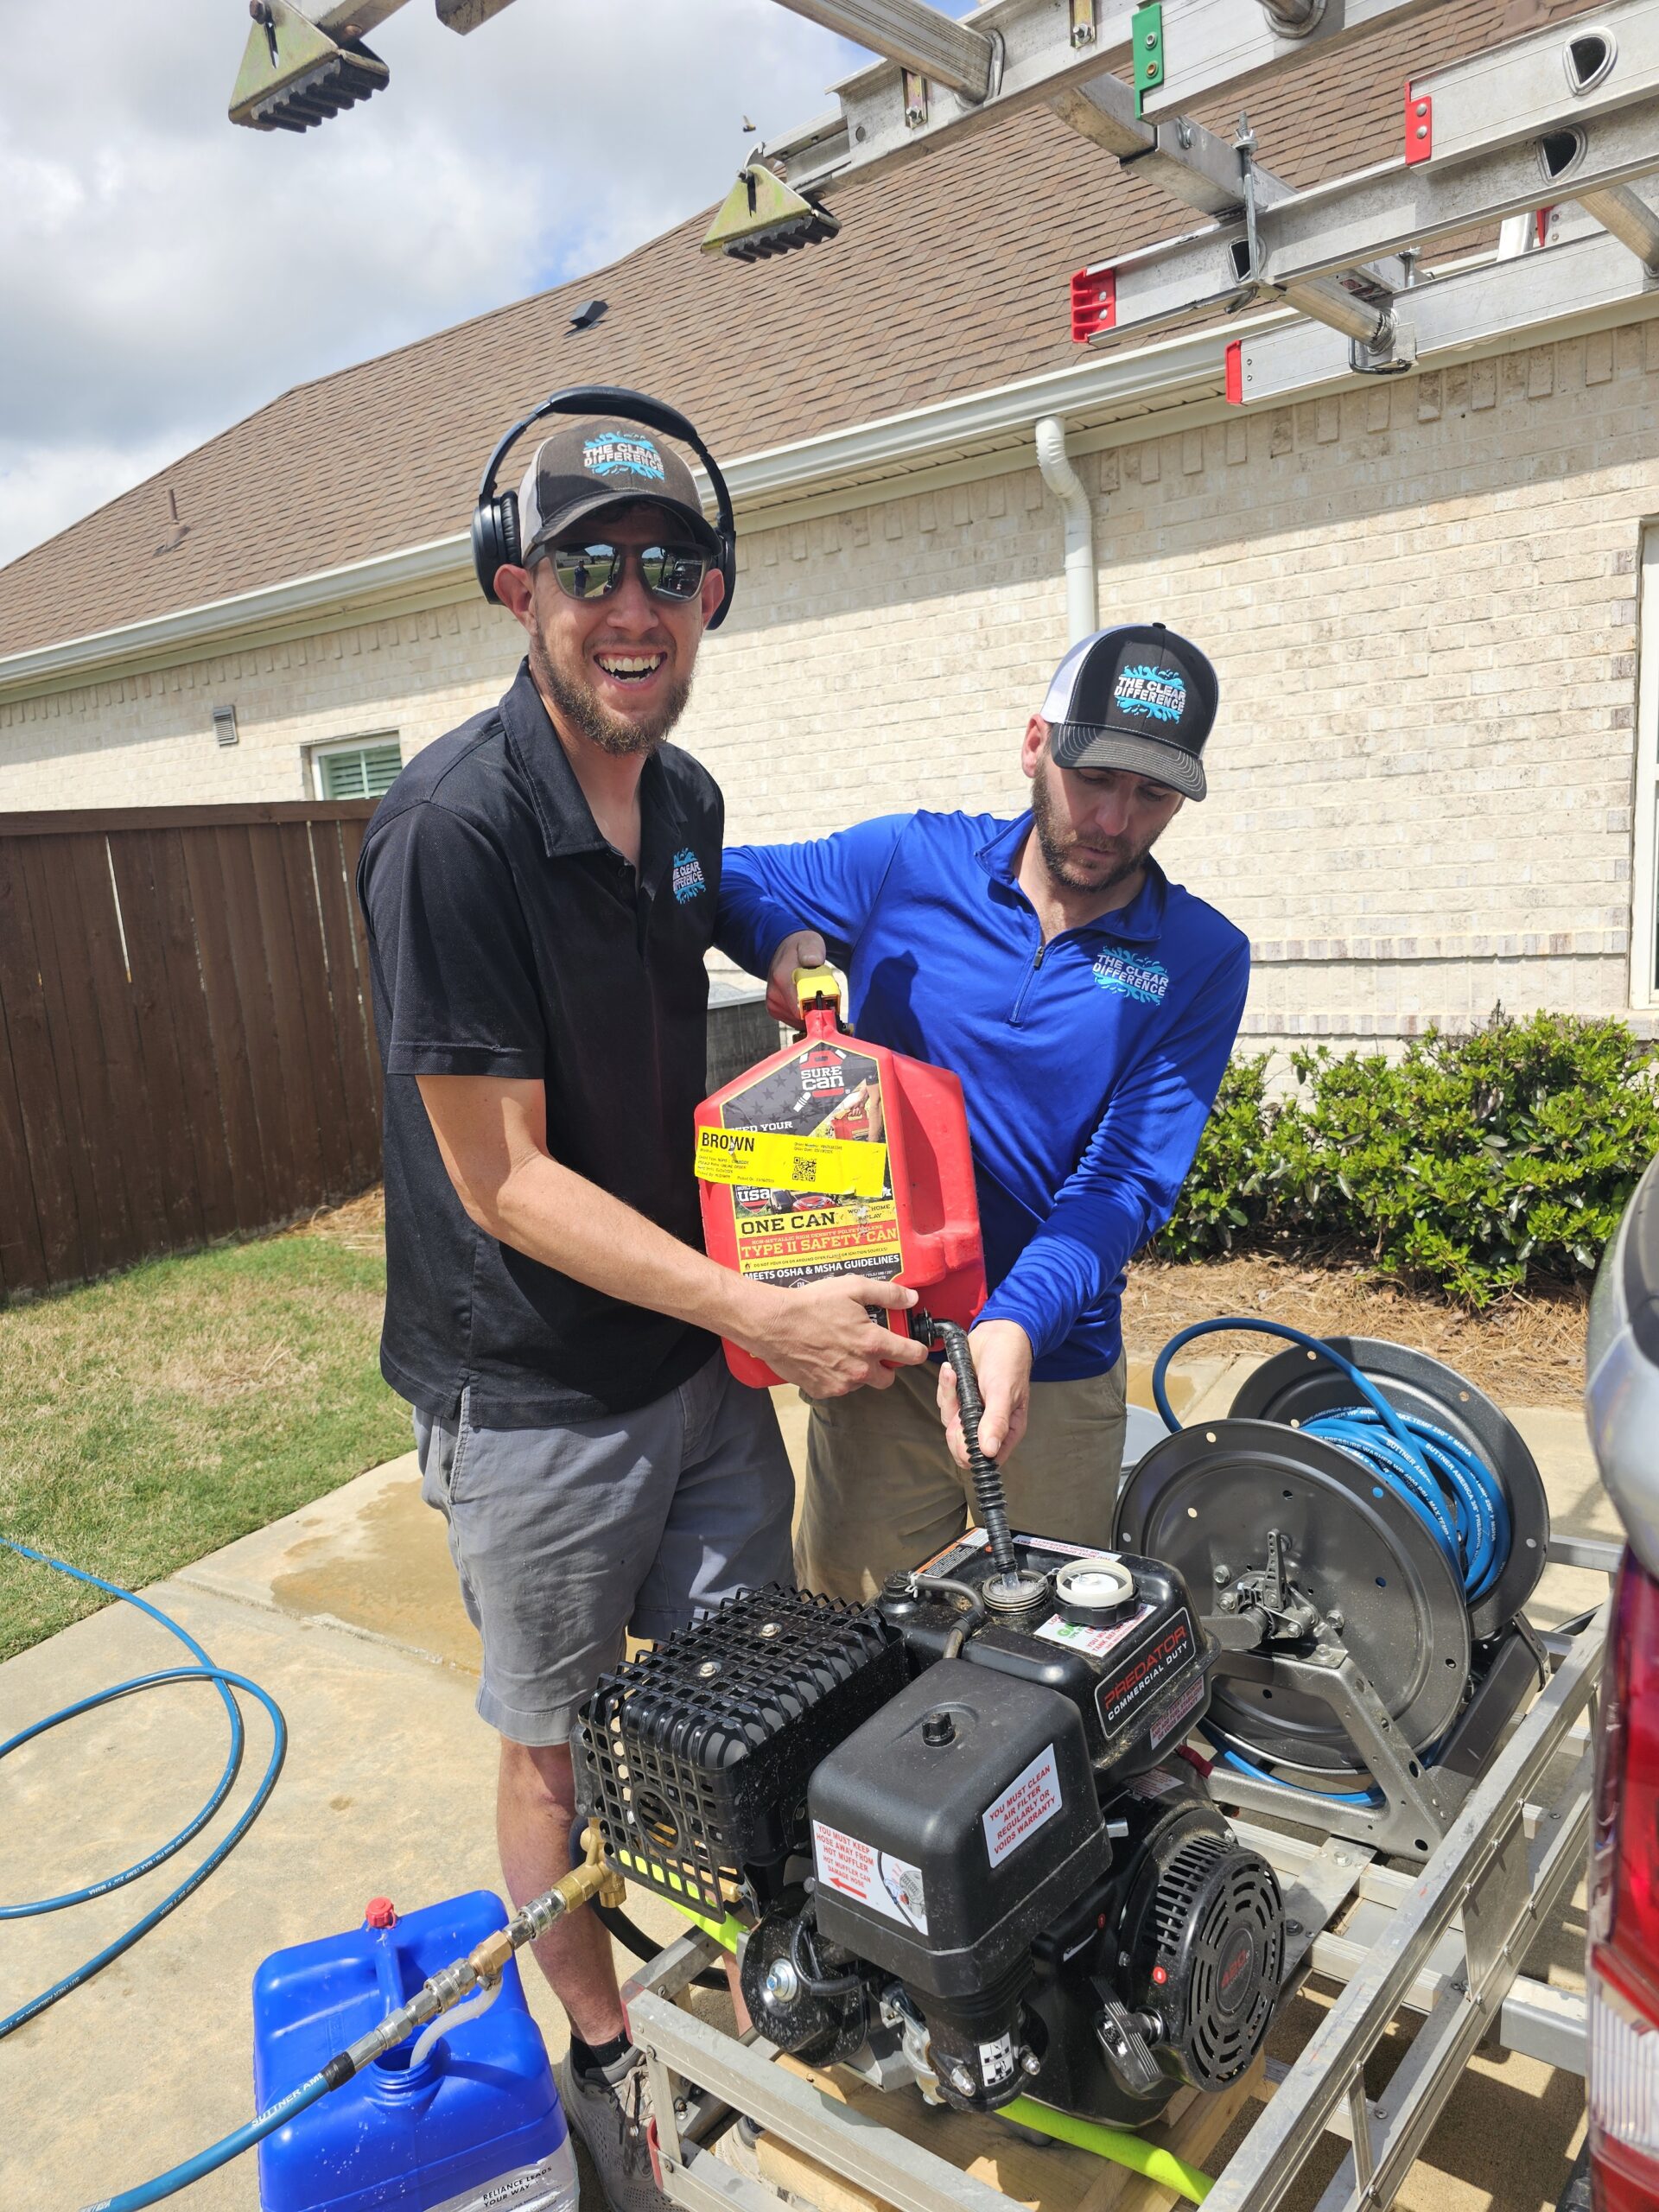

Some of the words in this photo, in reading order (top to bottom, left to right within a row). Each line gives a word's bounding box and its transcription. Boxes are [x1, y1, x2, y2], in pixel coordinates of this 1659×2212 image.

[582, 442, 613, 458] THE
[616, 442, 663, 463] CLEAR
[584, 452, 664, 472] DIFFERENCE
[1114, 685, 1185, 713] DIFFERENCE
[1118, 677, 1143, 690] THE
[1147, 681, 1187, 702] CLEAR
[680, 861, 701, 877] CLEAR
[1092, 963, 1166, 996] DIFFERENCE
[1097, 954, 1124, 969] THE
[1125, 965, 1169, 987] CLEAR
[801, 1065, 842, 1081] SURE
[760, 1121, 793, 1132] YOUR
[702, 1132, 755, 1152] BROWN
[741, 1217, 785, 1235] ONE
[791, 1211, 835, 1230] CAN
[741, 1243, 784, 1258] TYPE
[787, 1241, 798, 1253] II
[800, 1233, 862, 1252] SAFETY
[866, 1228, 898, 1243] CAN
[745, 1270, 776, 1281] MEETS
[777, 1267, 804, 1278] OSHA
[805, 1266, 813, 1274] &
[815, 1262, 842, 1273] MSHA
[844, 1254, 899, 1269] GUIDELINES
[1412, 1417, 1433, 1428] TEMP
[1453, 1440, 1472, 1457] MSHA
[1386, 1439, 1416, 1467] SUTTNER
[1425, 1442, 1455, 1471] SUTTNER
[1452, 1470, 1474, 1501] AMERICA
[1104, 1624, 1187, 1710] PREDATOR
[1108, 1665, 1164, 1721] COMMERCIAL
[1166, 1640, 1188, 1665] DUTY
[989, 1805, 1005, 1821] YOU
[1006, 1785, 1026, 1808] MUST
[1027, 1764, 1052, 1789] CLEAN
[1003, 1807, 1016, 1822] AIR
[1017, 1785, 1041, 1810] FILTER
[994, 1832, 1016, 1854] VOIDS
[1017, 1796, 1056, 1834] WARRANTY
[997, 1800, 1038, 1840] REGULARLY
[1039, 1789, 1050, 1802] OR
[817, 1825, 831, 1837] YOU
[833, 1832, 851, 1844] MUST
[853, 1840, 870, 1853] KEEP
[817, 1833, 834, 1847] HOSE
[836, 1841, 854, 1856] AWAY
[855, 1852, 874, 1866] FROM
[823, 1845, 836, 1857] HOT
[838, 1852, 868, 1872] MUFFLER
[823, 1855, 834, 1866] HOT
[835, 1861, 858, 1878] MUFFLER
[860, 1872, 871, 1884] CAN
[828, 1866, 849, 1881] DAMAGE
[850, 1877, 865, 1888] HOSE
[251, 2088, 302, 2127] SUTTNER
[483, 2178, 524, 2201] RELIANCE
[526, 2166, 552, 2182] LEADS
[484, 2194, 508, 2208] YOUR
